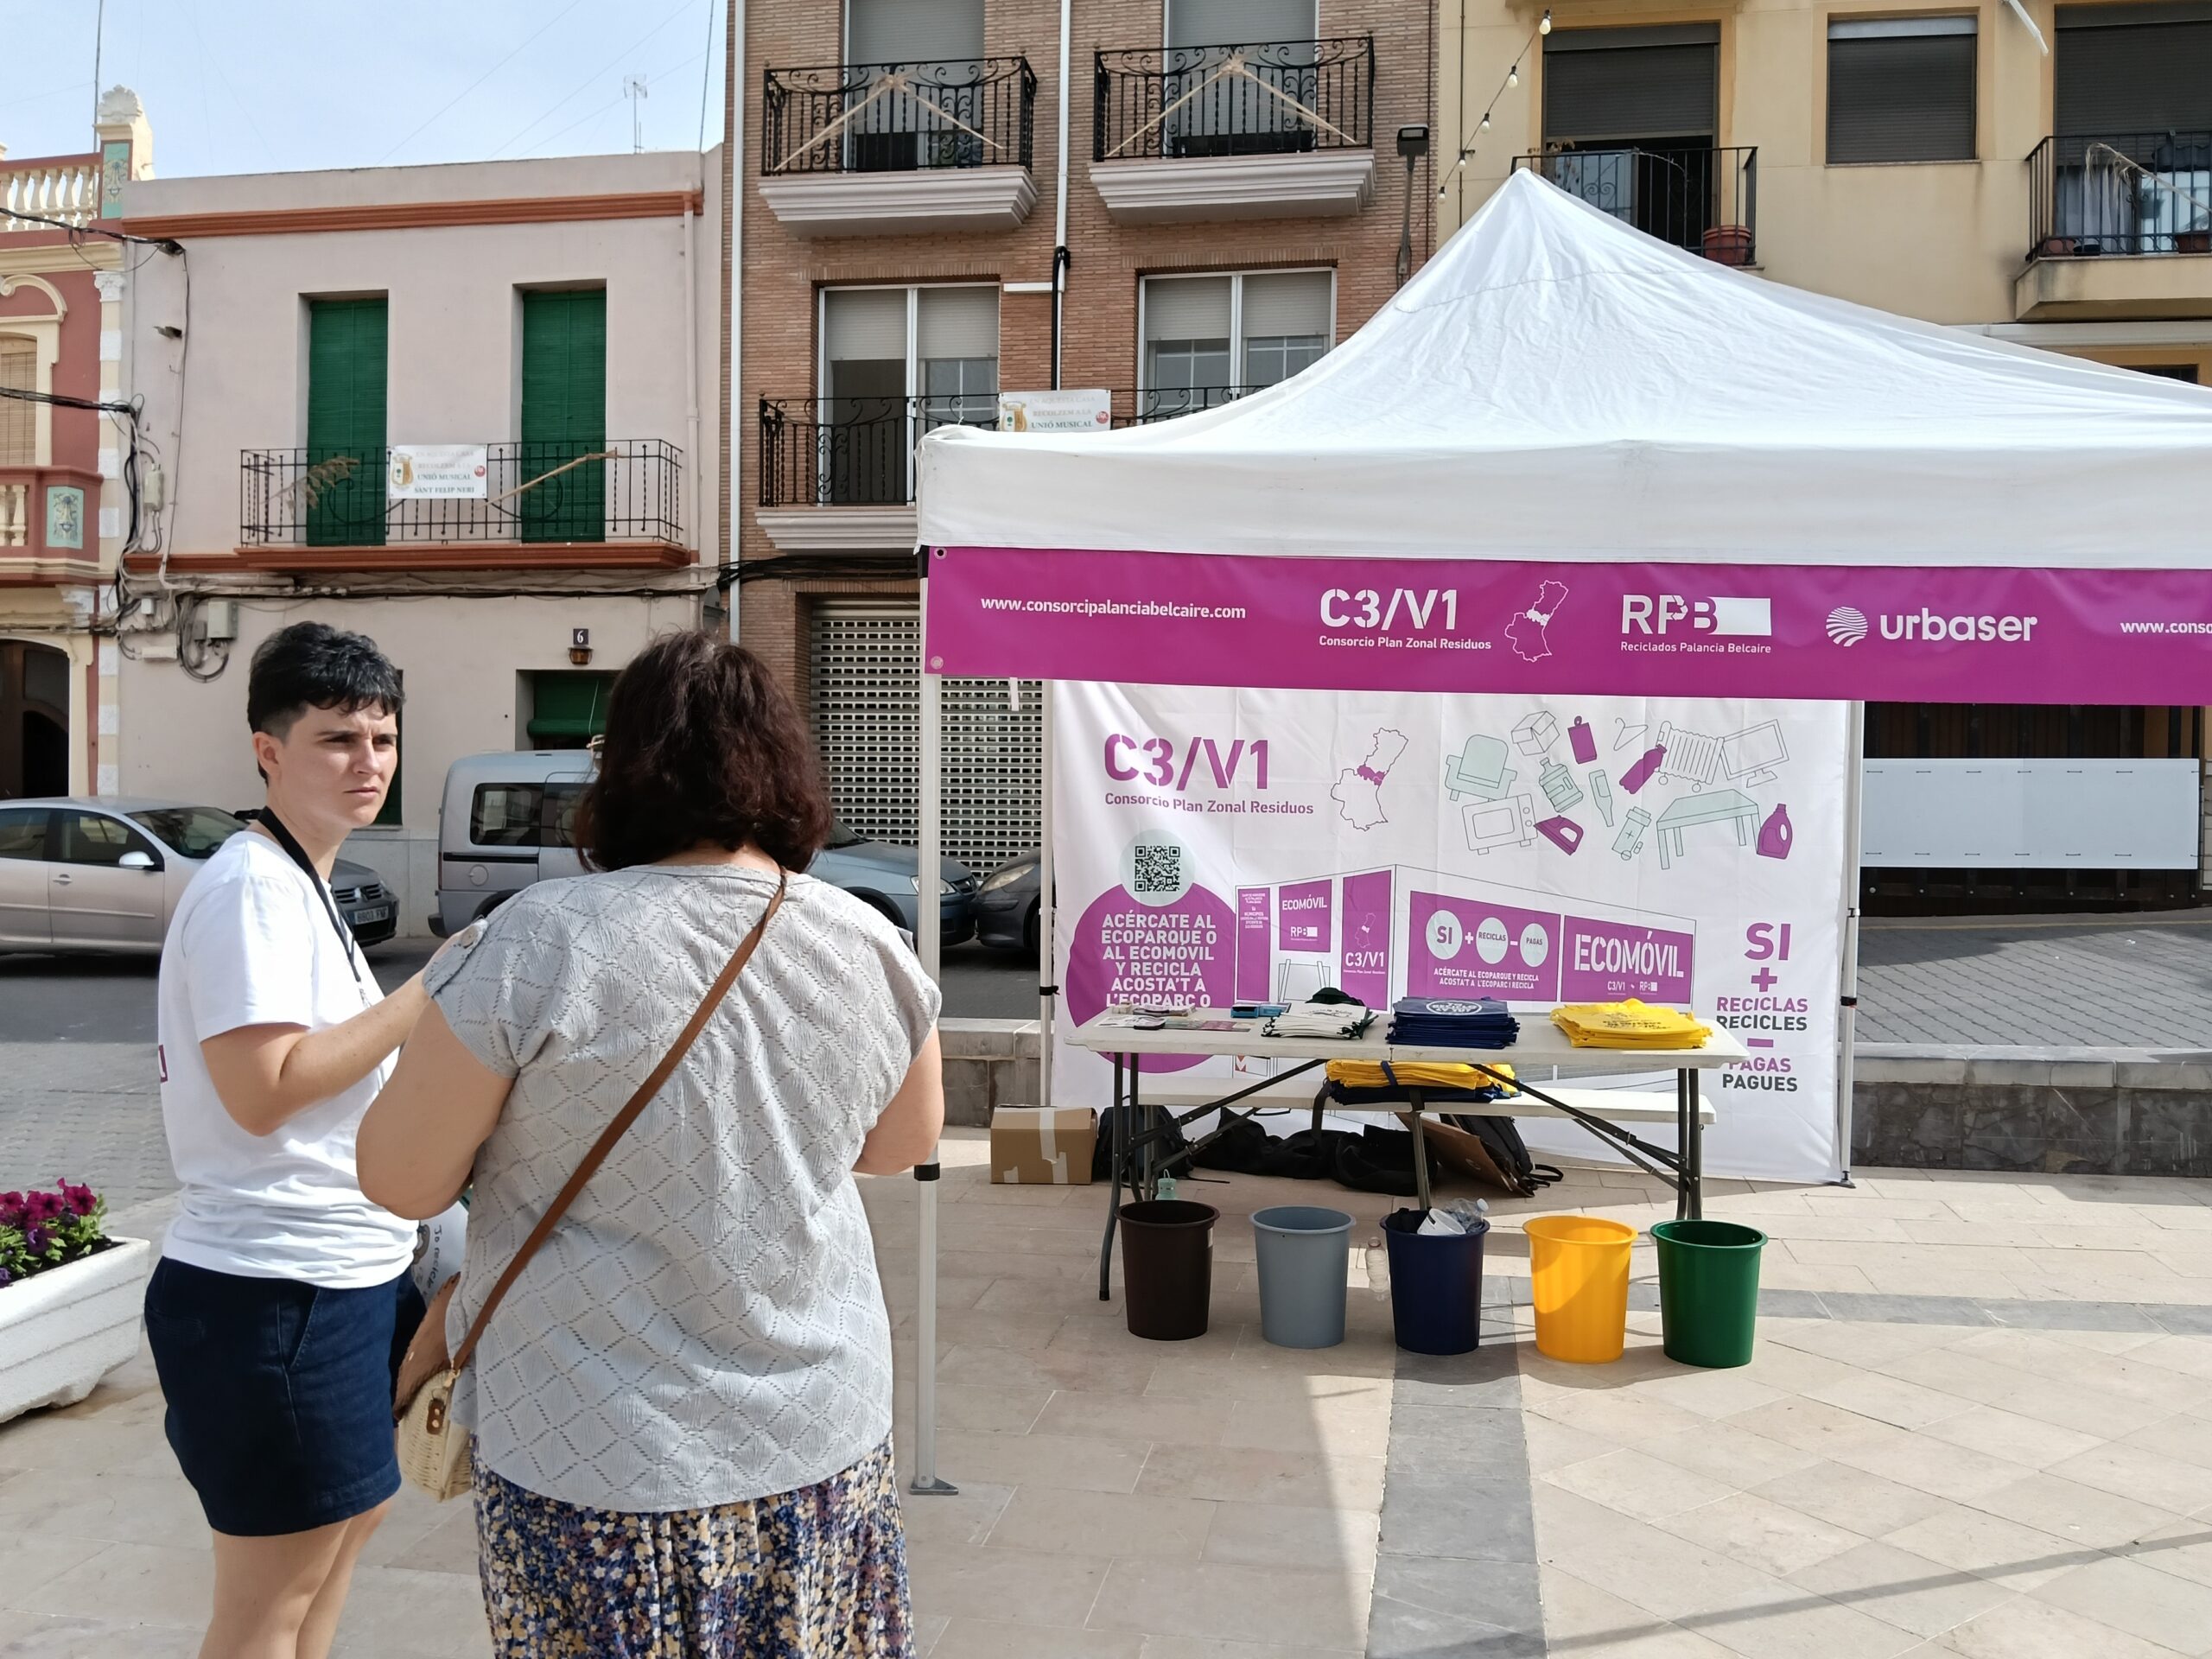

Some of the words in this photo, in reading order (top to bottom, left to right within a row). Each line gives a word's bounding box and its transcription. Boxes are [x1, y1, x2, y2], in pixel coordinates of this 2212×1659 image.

[1031, 420, 1054, 429] UNIÓ
[981, 597, 1246, 620] www.consorcipalanciabelcaire.com
[1320, 588, 1458, 631] C3/V1
[1879, 607, 2038, 642] urbaser
[576, 630, 584, 644] 6
[1319, 635, 1375, 647] Consorcio
[1377, 637, 1403, 648] Plan
[1406, 638, 1438, 649] Zonal
[1440, 639, 1492, 650] Residuos
[1620, 641, 1677, 652] Reciclados
[1680, 642, 1725, 652] Palancia
[1727, 643, 1771, 653] Belcaire
[1104, 733, 1269, 791] C3/V1
[1105, 792, 1170, 808] Consorcio
[1173, 798, 1204, 812] Plan
[1207, 800, 1247, 814] Zonal
[1249, 800, 1314, 815] Residuos
[1281, 894, 1328, 911] ECOMÓVIL
[1102, 909, 1190, 929] ACÉRCATE
[1193, 914, 1217, 929] AL
[1101, 930, 1202, 944] ECOPARQUE
[1205, 931, 1217, 944] O
[1436, 925, 1453, 944] SI
[1478, 931, 1507, 942] RECICLAS
[1525, 937, 1543, 945] PAGAS
[1744, 922, 1791, 961] SI
[1103, 945, 1126, 960] AL
[1129, 942, 1215, 961] ECOMÓVIL
[1344, 951, 1385, 968] C3/V1
[1573, 930, 1685, 978] ECOMÓVIL
[1115, 962, 1127, 976] Y
[1130, 962, 1202, 976] RECICLA
[1433, 966, 1468, 977] ACÉRCATE
[1478, 970, 1512, 981] ECOPARQUE
[1111, 977, 1191, 992] ACOSTA'T
[1194, 977, 1206, 992] A
[1607, 981, 1625, 991] C3/V1
[1199, 994, 1211, 1007] O
[1716, 996, 1808, 1013] RECICLAS
[1716, 1014, 1808, 1031] RECICLES
[1722, 1073, 1798, 1092] PAGUES
